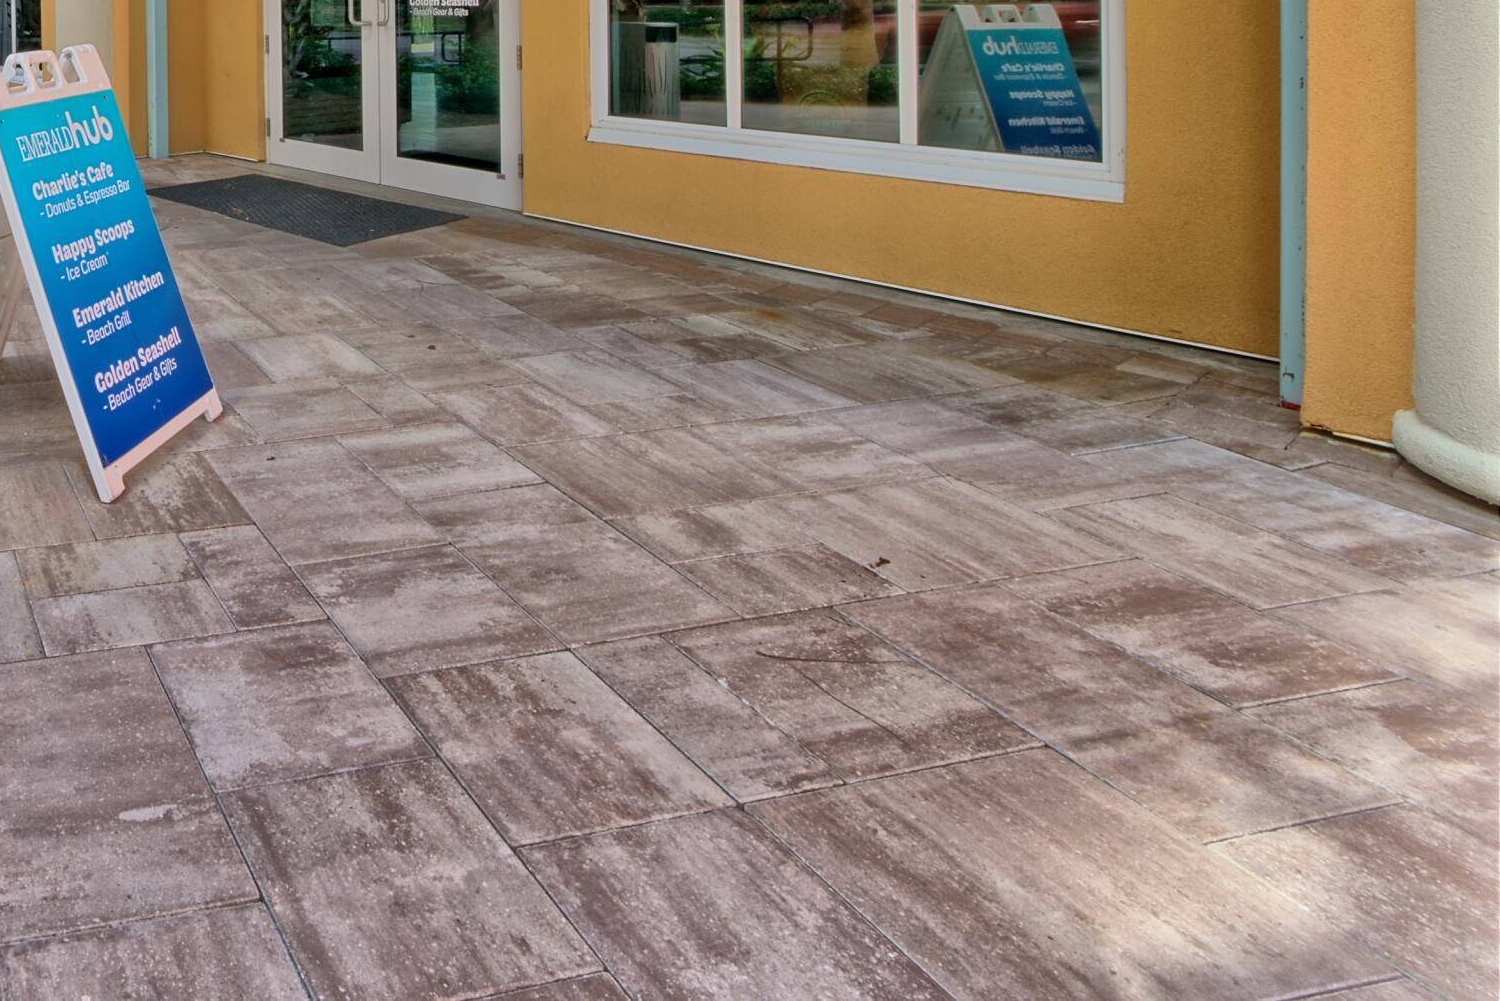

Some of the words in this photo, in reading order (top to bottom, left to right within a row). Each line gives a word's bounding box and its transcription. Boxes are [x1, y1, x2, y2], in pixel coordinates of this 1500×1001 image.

[32, 170, 88, 201] Charlie's
[87, 161, 114, 184] Cafe
[45, 198, 76, 218] Donuts
[76, 193, 84, 207] &
[83, 184, 118, 205] Espresso
[117, 180, 131, 193] Bar
[51, 235, 96, 264] Happy
[94, 219, 135, 246] Scoops
[66, 266, 81, 282] Ice
[80, 254, 108, 275] Cream
[72, 287, 126, 328] Emerald
[123, 271, 164, 302] Kitchen
[86, 320, 115, 346] Beach
[114, 310, 132, 330] Grill
[94, 359, 140, 393] Golden
[138, 326, 182, 367] Seashell
[107, 383, 136, 411] Beach
[134, 372, 154, 393] Gear
[152, 366, 162, 381] &
[160, 357, 178, 376] Gifts
